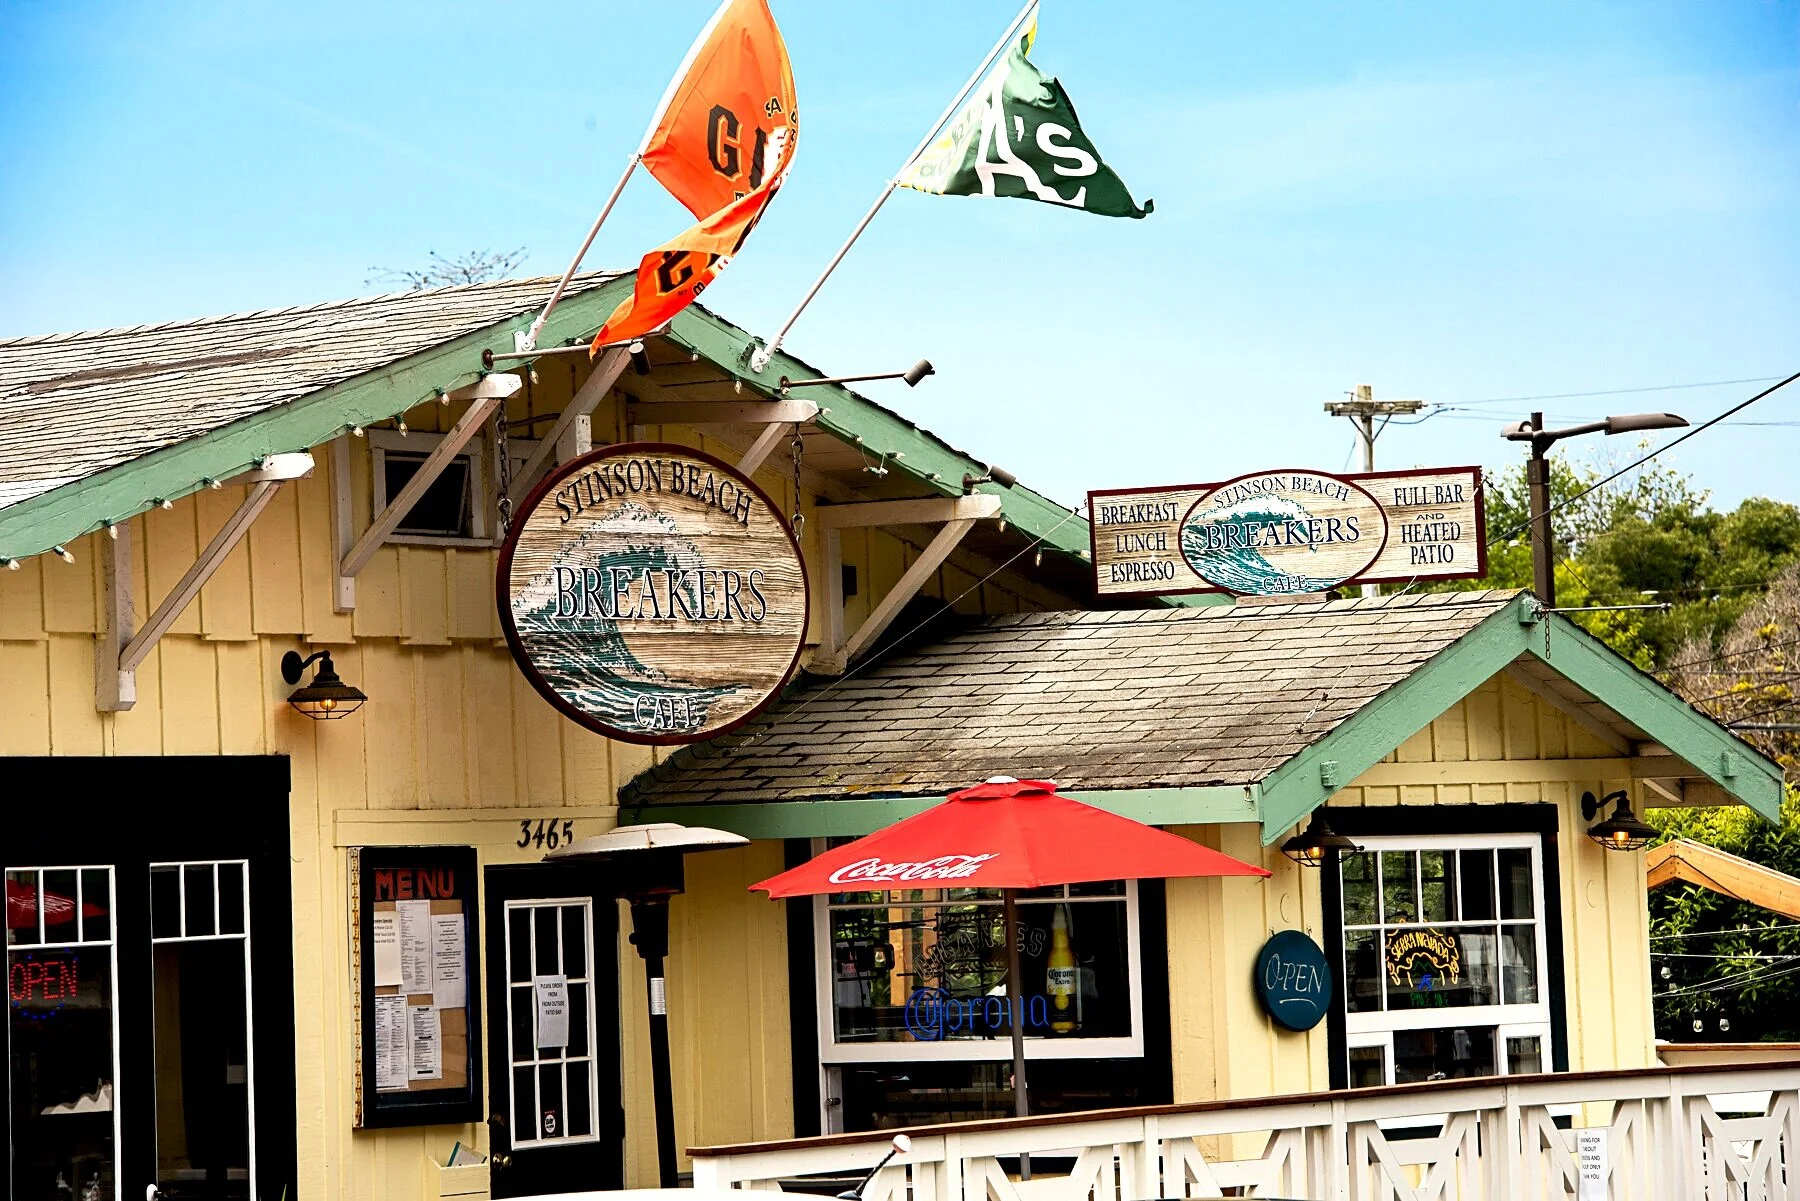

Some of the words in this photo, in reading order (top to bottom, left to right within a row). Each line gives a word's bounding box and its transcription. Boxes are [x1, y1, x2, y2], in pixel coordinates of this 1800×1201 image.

[555, 459, 663, 524] STINSON
[670, 460, 754, 526] BEACH
[1213, 475, 1288, 509] STINSON
[1290, 475, 1350, 502] BEACH
[1393, 486, 1432, 507] FULL
[1434, 484, 1465, 505] BAR
[1101, 502, 1179, 526] BREAKFAST
[1416, 513, 1445, 521] AND
[1115, 531, 1168, 553] LUNCH
[1204, 515, 1361, 552] BREAKERS
[1401, 521, 1461, 544] HEATED
[1410, 543, 1455, 565] PATIO
[1111, 560, 1175, 583] ESPRESSO
[1262, 574, 1309, 592] CAFE
[553, 566, 768, 623] BREAKERS
[633, 694, 702, 729] CAFE
[517, 817, 574, 850] 3465
[375, 868, 454, 900] MENU
[1391, 932, 1416, 961] SIERRA
[1416, 932, 1449, 962] NEVADA
[9, 959, 77, 1001] OPEN
[1265, 953, 1327, 993] OPEN
[905, 987, 1049, 1041] Corona
